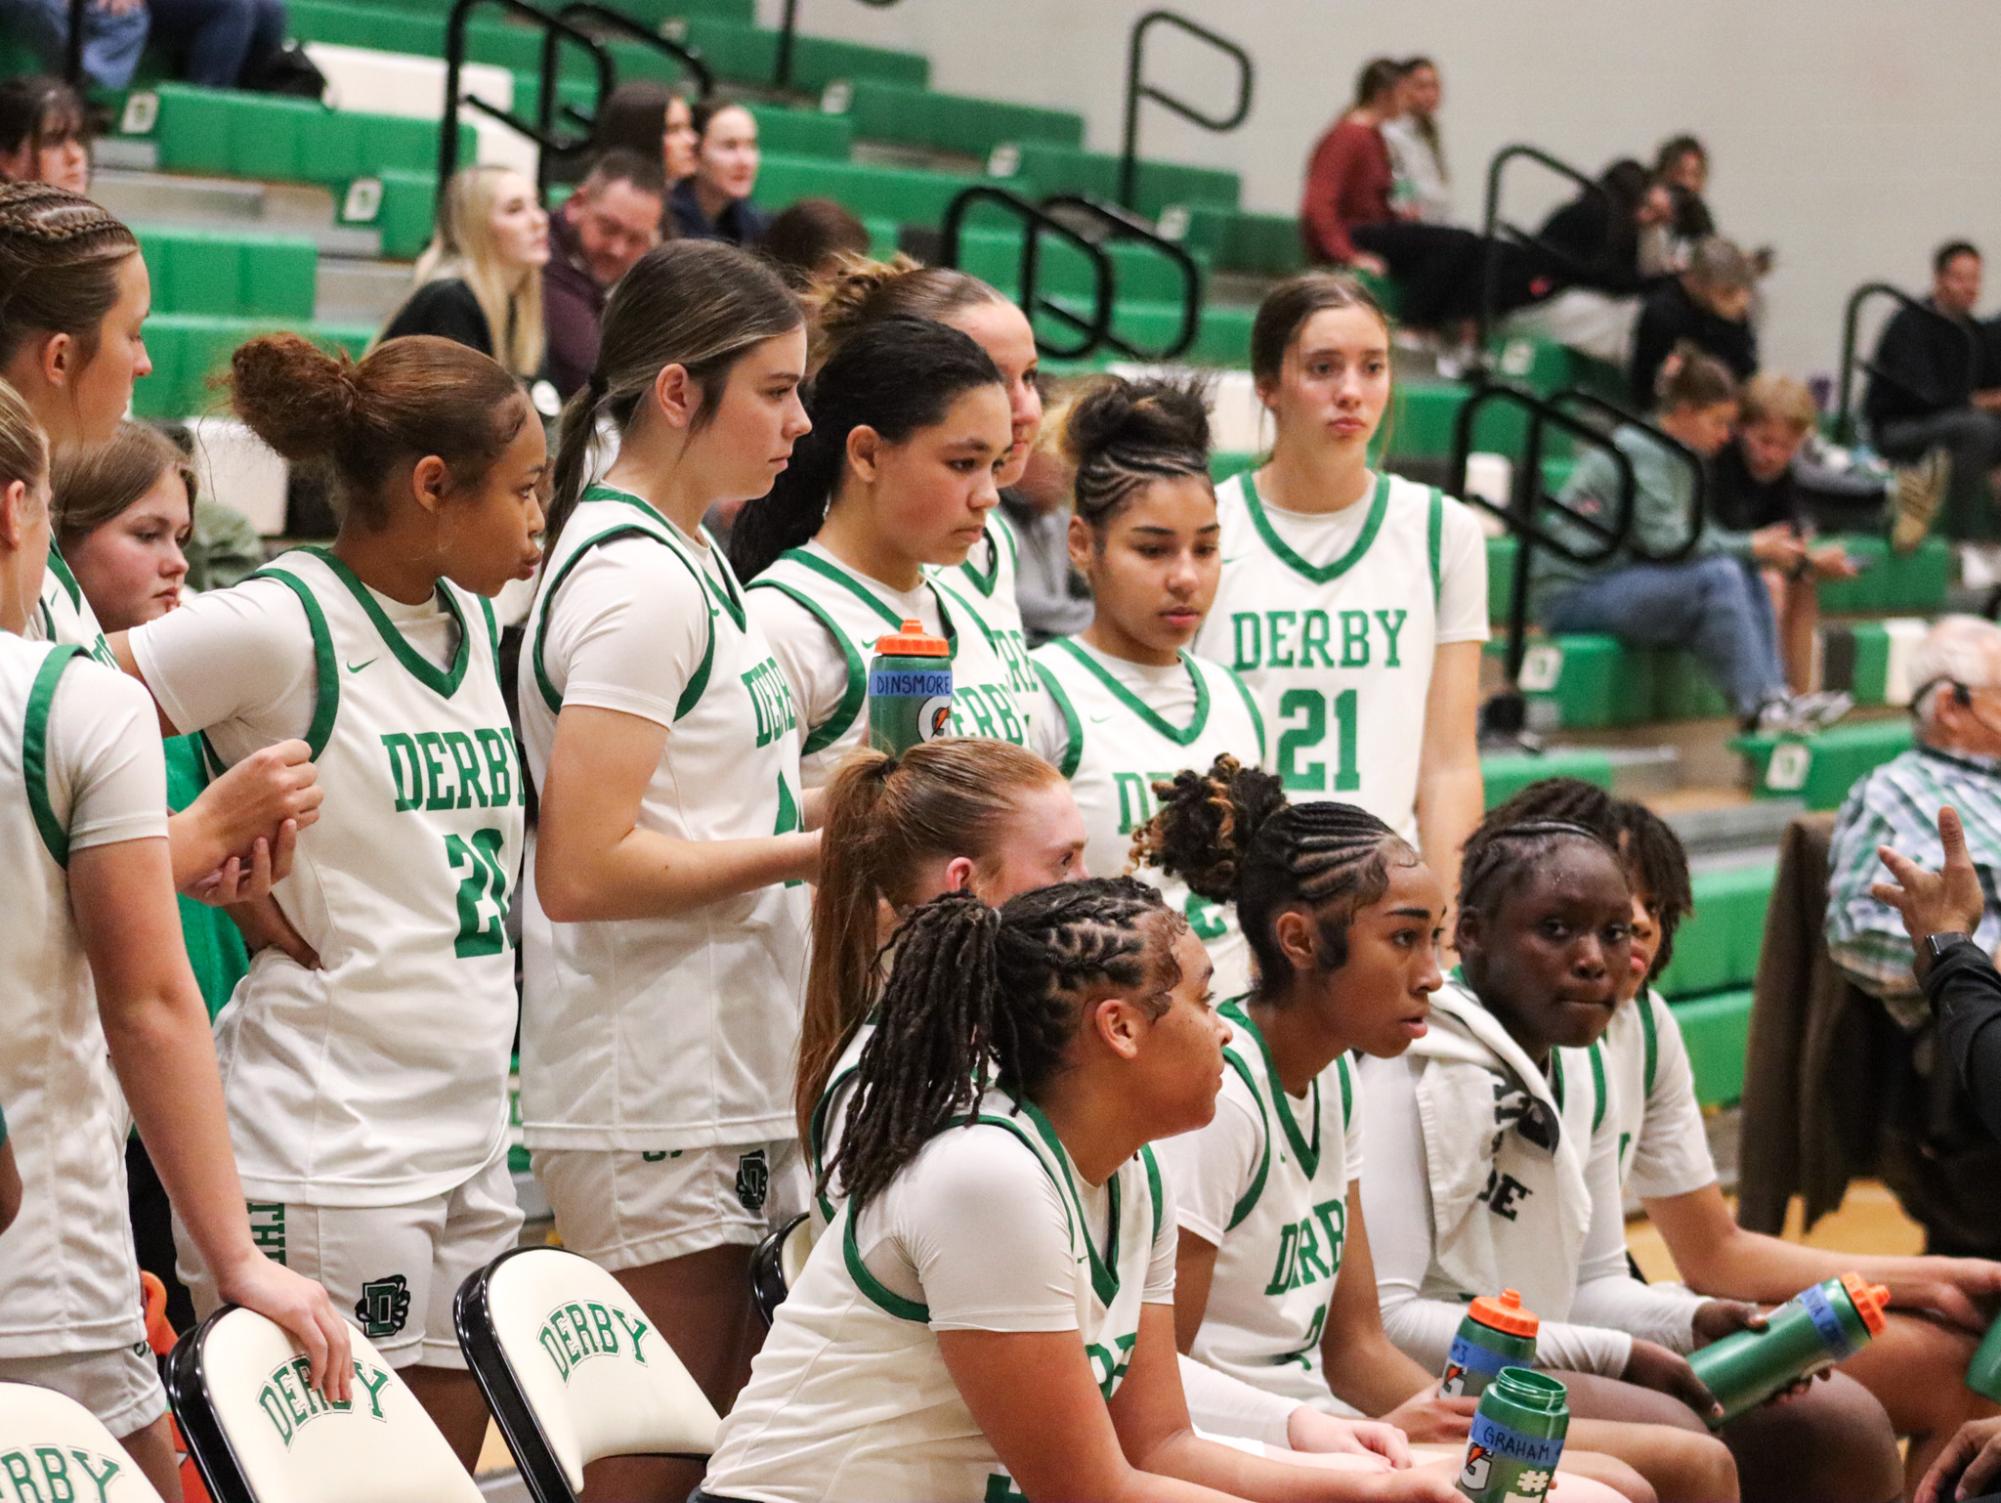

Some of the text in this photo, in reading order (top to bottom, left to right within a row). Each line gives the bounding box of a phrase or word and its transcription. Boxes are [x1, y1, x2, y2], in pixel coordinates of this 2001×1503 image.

[1231, 609, 1407, 671] DERBY
[740, 656, 797, 749] DERB
[876, 674, 951, 695] DINSMORE
[1277, 689, 1360, 792] 21
[539, 1302, 649, 1383] DERBY
[258, 1357, 389, 1447] DERY
[0, 1447, 120, 1503] RBY
[1483, 1426, 1550, 1460] GRAHAM
